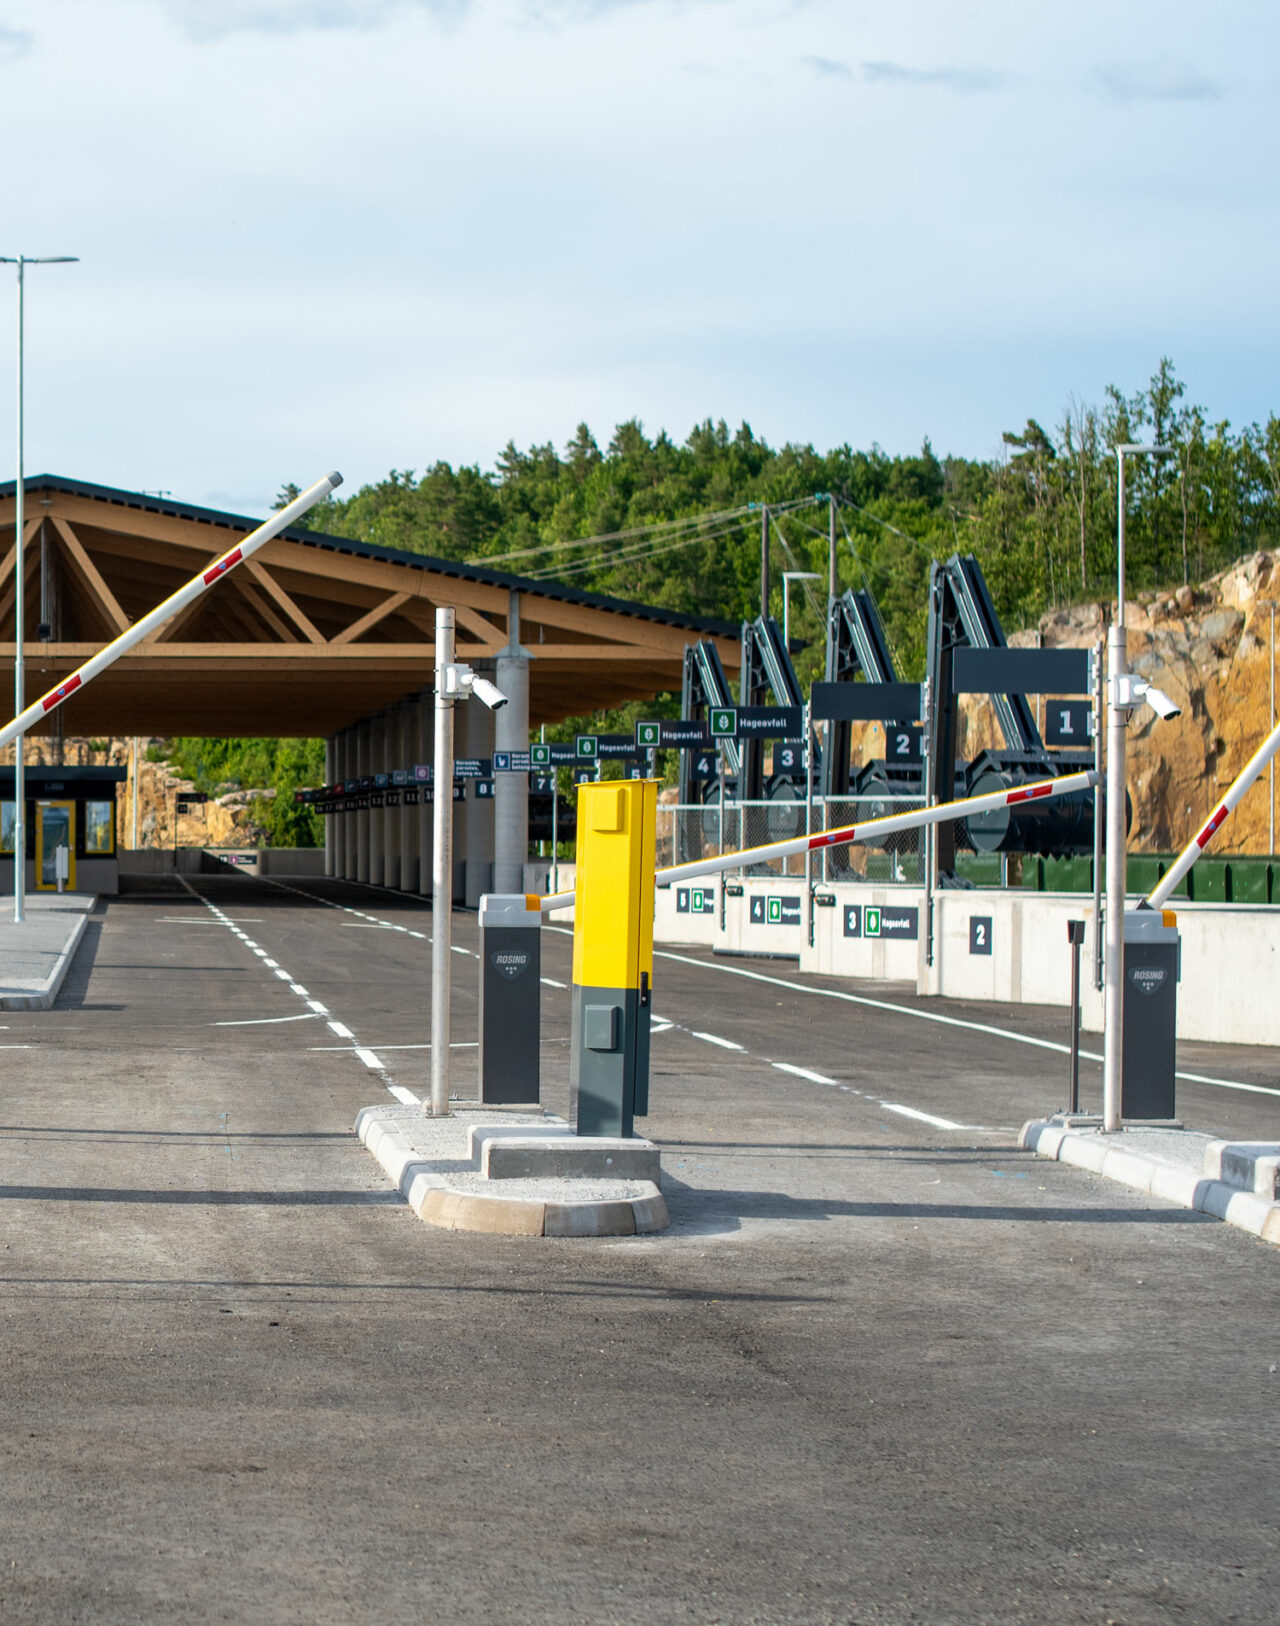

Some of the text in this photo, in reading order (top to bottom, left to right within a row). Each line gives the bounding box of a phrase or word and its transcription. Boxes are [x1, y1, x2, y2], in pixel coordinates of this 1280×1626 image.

[739, 718, 787, 730] Hageavfall
[1059, 711, 1074, 734] 1
[662, 730, 703, 741] Hageavfall
[600, 744, 635, 753] Hageavfall
[896, 734, 910, 754] 2
[781, 750, 794, 767] 3
[698, 758, 709, 773] 4
[631, 768, 640, 780] 5
[479, 783, 488, 795] 8
[537, 778, 546, 790] 7
[680, 892, 687, 908] 5
[754, 901, 762, 918] 4
[848, 911, 857, 930] 3
[882, 918, 911, 929] Hageavfall
[976, 924, 986, 946] 2
[496, 954, 528, 965] ROSING
[1133, 970, 1164, 980] ROSING
